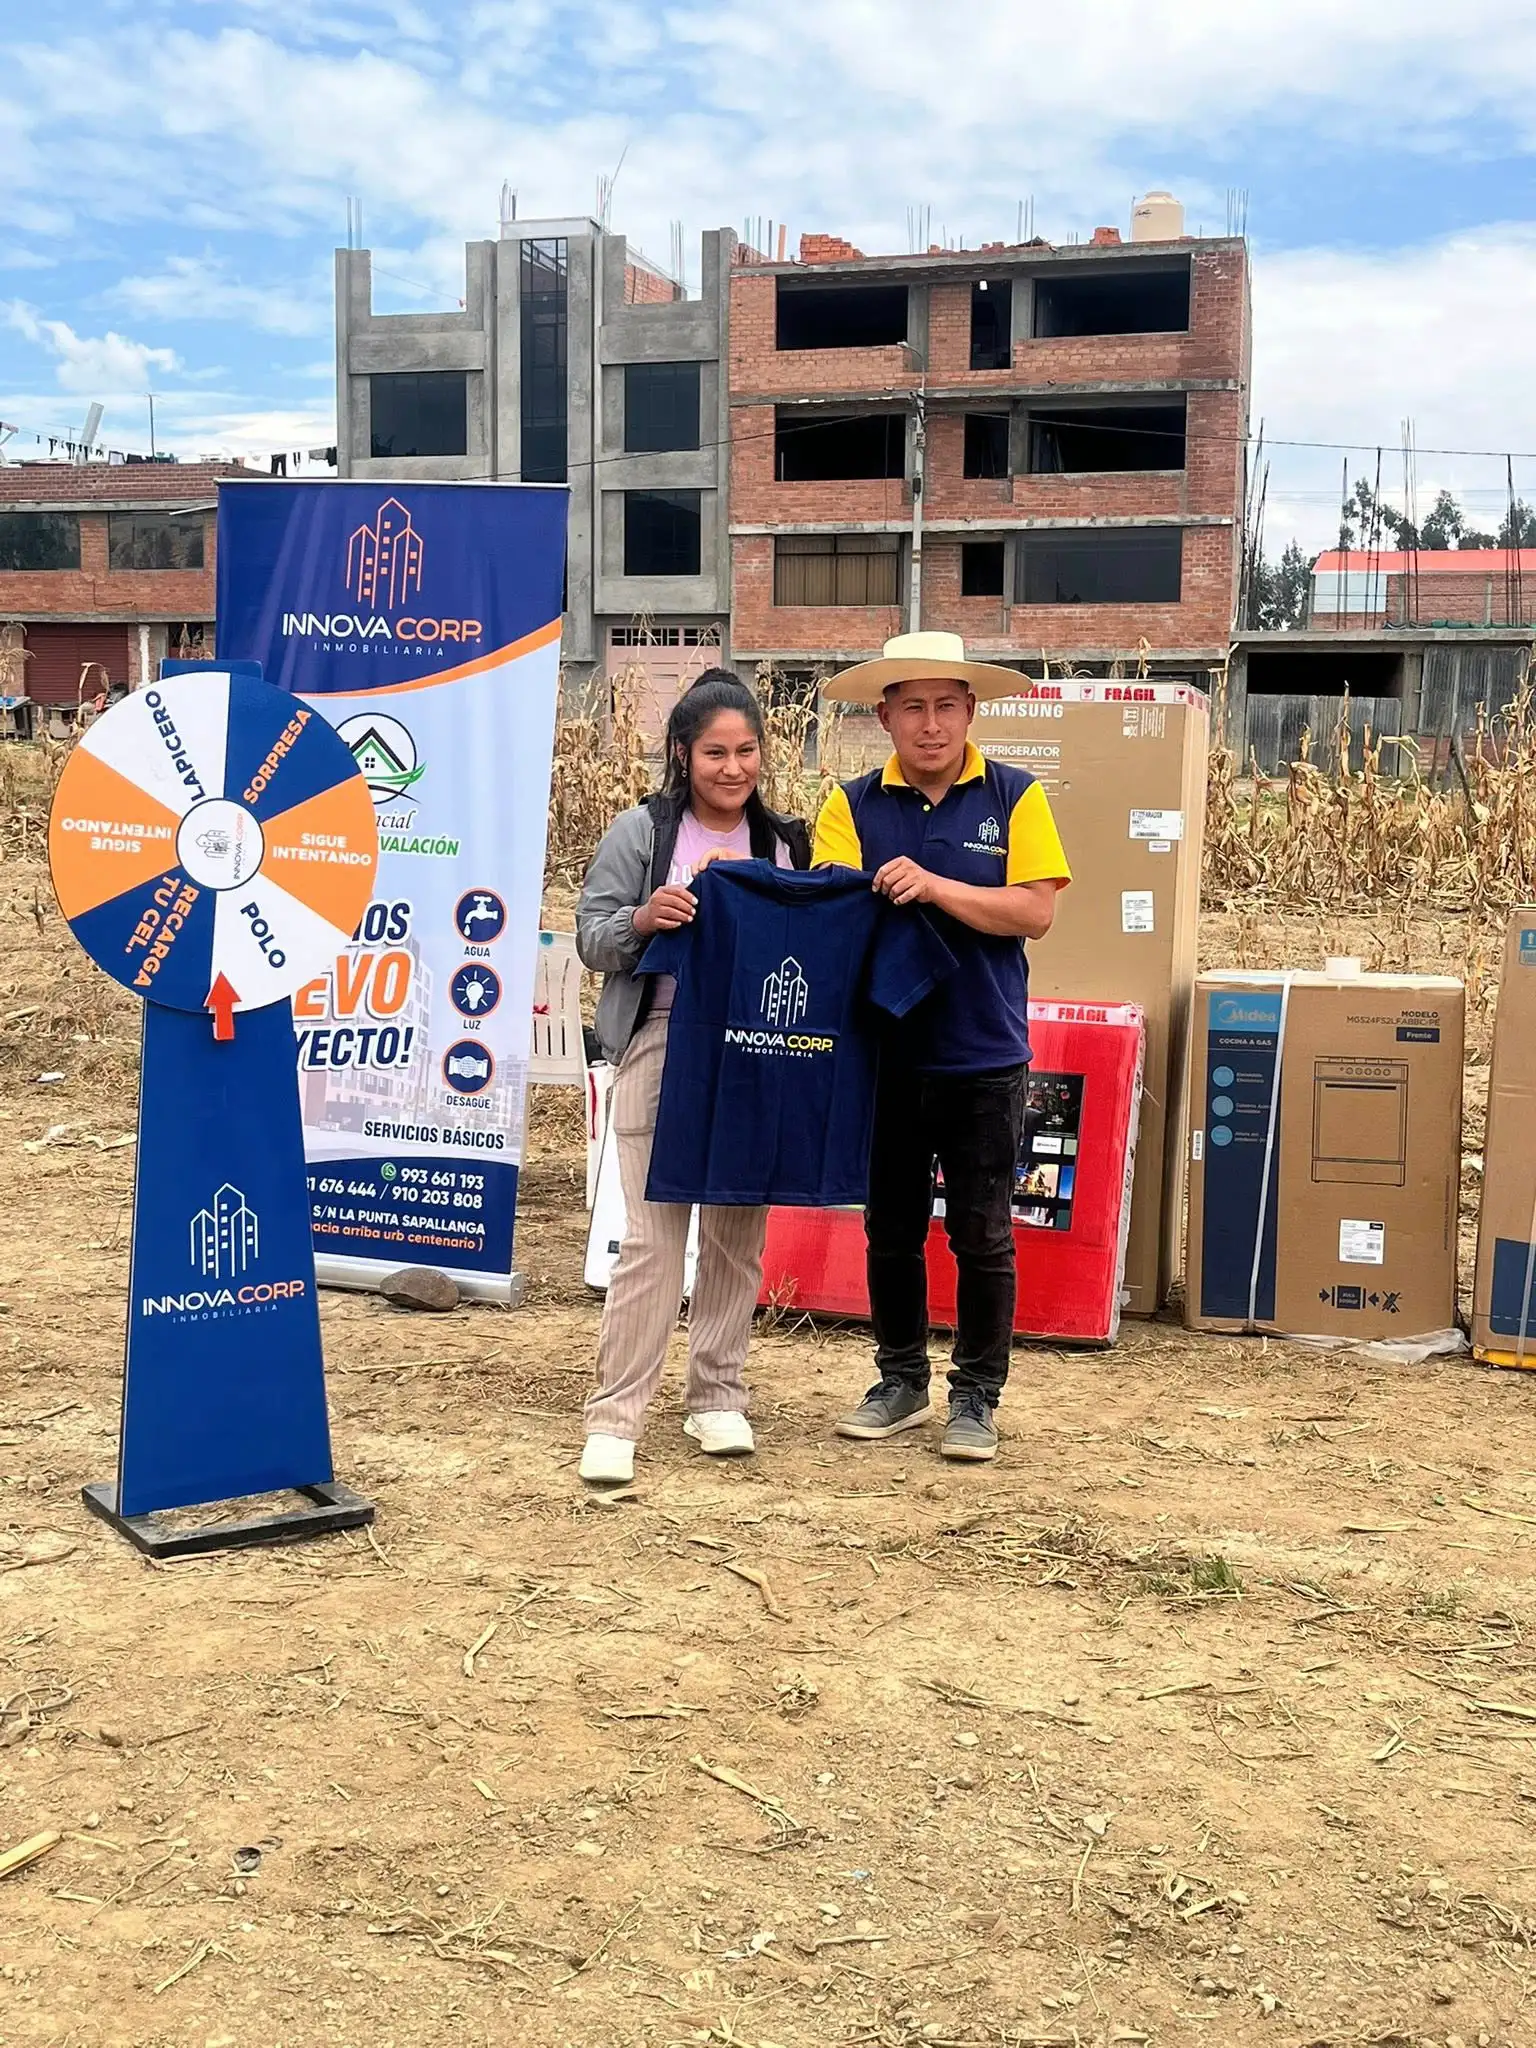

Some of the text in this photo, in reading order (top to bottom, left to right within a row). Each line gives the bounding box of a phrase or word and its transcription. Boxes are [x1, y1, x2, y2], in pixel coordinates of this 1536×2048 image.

[283, 613, 482, 643] INNOVA CORP.
[314, 642, 443, 656] INMOBILIARIA
[1012, 683, 1156, 701] ÁGIL FRÁGIL
[979, 702, 1064, 718] SAMSUNG
[145, 690, 206, 802] LAPICERO
[979, 744, 1060, 757] REFRIGERATOR
[243, 709, 312, 804] SORPRESA
[61, 818, 172, 840] INTENTANDO
[91, 837, 141, 853] SIGUE
[301, 832, 347, 848] SIGUE
[377, 835, 459, 856] VALACIÓN
[272, 846, 372, 866] INTENTANDO
[125, 876, 181, 953] TU CEL.
[133, 883, 200, 988] RECARGA
[240, 902, 286, 968] POLO
[464, 946, 490, 957] AGUA
[1058, 1006, 1108, 1022] FRÁGIL
[1401, 1010, 1439, 1019] MODELO
[463, 1020, 481, 1030] LUZ
[1406, 1031, 1432, 1039] Frente
[725, 1029, 833, 1052] INNOVA CORP.
[742, 1046, 813, 1058] INMOBILIARIA
[446, 1095, 491, 1109] DESAGÜE
[364, 1121, 505, 1150] SERVICIOS BÁSICOS
[401, 1168, 484, 1190] 993 661 193
[319, 1178, 345, 1194] 676
[347, 1181, 376, 1198] 444
[379, 1183, 389, 1200] /
[392, 1186, 418, 1202] 910
[422, 1189, 450, 1205] 203
[453, 1192, 483, 1209] 808
[312, 1204, 486, 1236] S/N LA PUNTA SAPALLANGA
[311, 1221, 340, 1234] acia
[342, 1224, 380, 1239] arriba
[383, 1228, 405, 1242] urb
[408, 1233, 475, 1250] centenario
[142, 1280, 305, 1316] INNOVA CORP.
[172, 1304, 278, 1324] INMOBILIARIA
